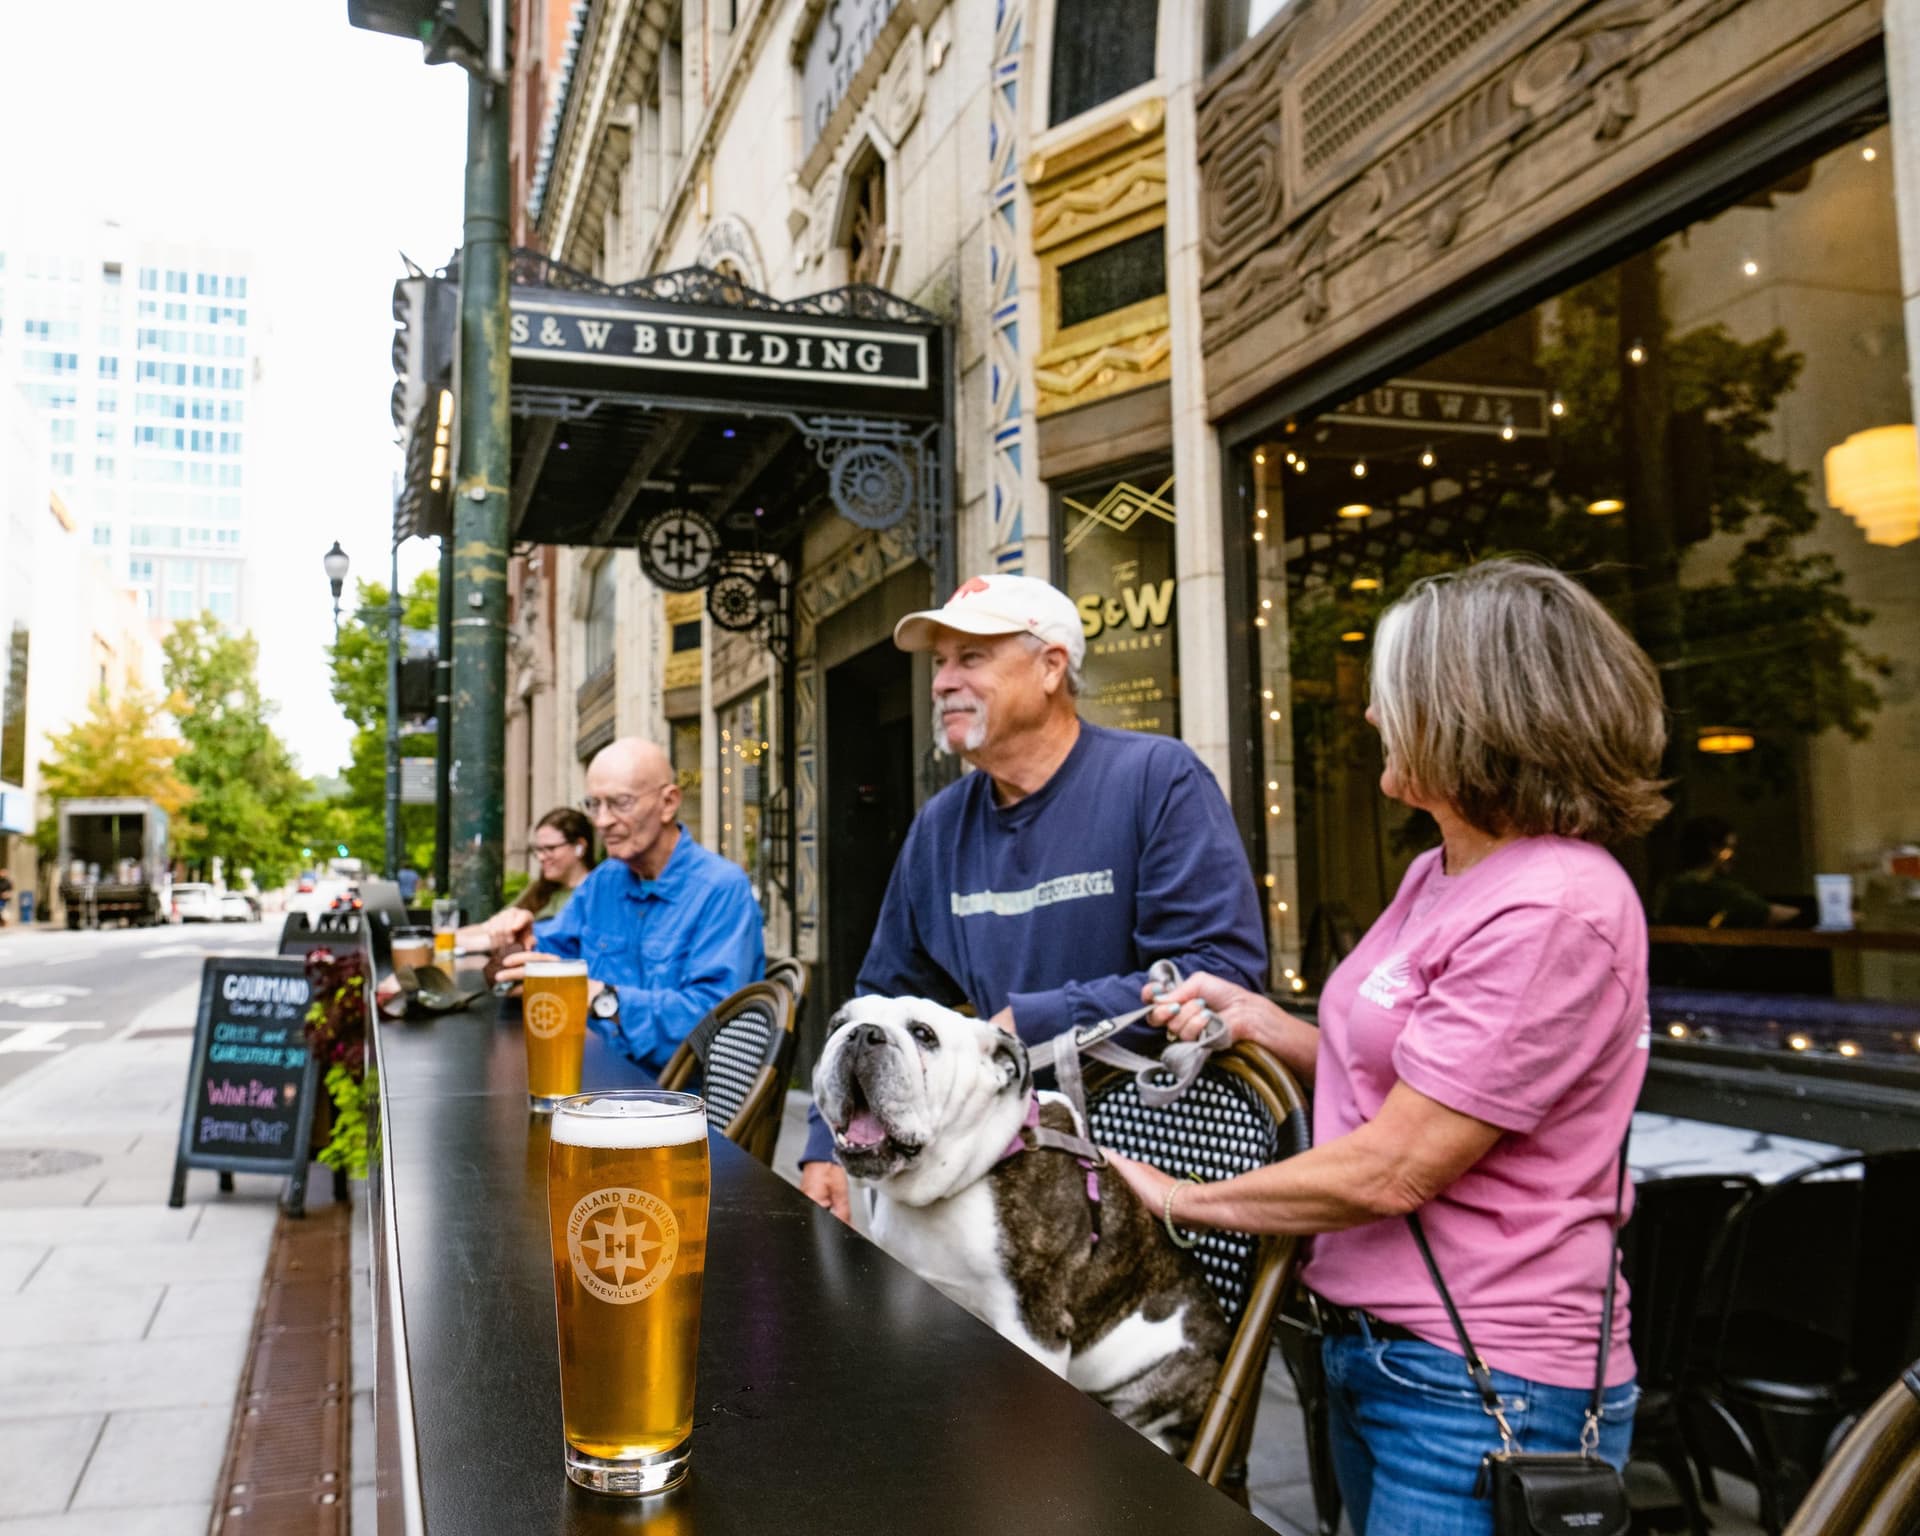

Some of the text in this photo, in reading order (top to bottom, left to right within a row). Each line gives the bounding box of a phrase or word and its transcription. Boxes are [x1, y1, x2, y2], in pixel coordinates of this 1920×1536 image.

[633, 324, 884, 373] BUILDING
[1077, 579, 1175, 638] S&W
[1094, 633, 1163, 655] MARKET
[222, 974, 310, 1006] GOURMAND
[570, 1192, 676, 1237] HIGHLAND BREWING
[583, 1274, 658, 1299] ASHEVILLE, NC
